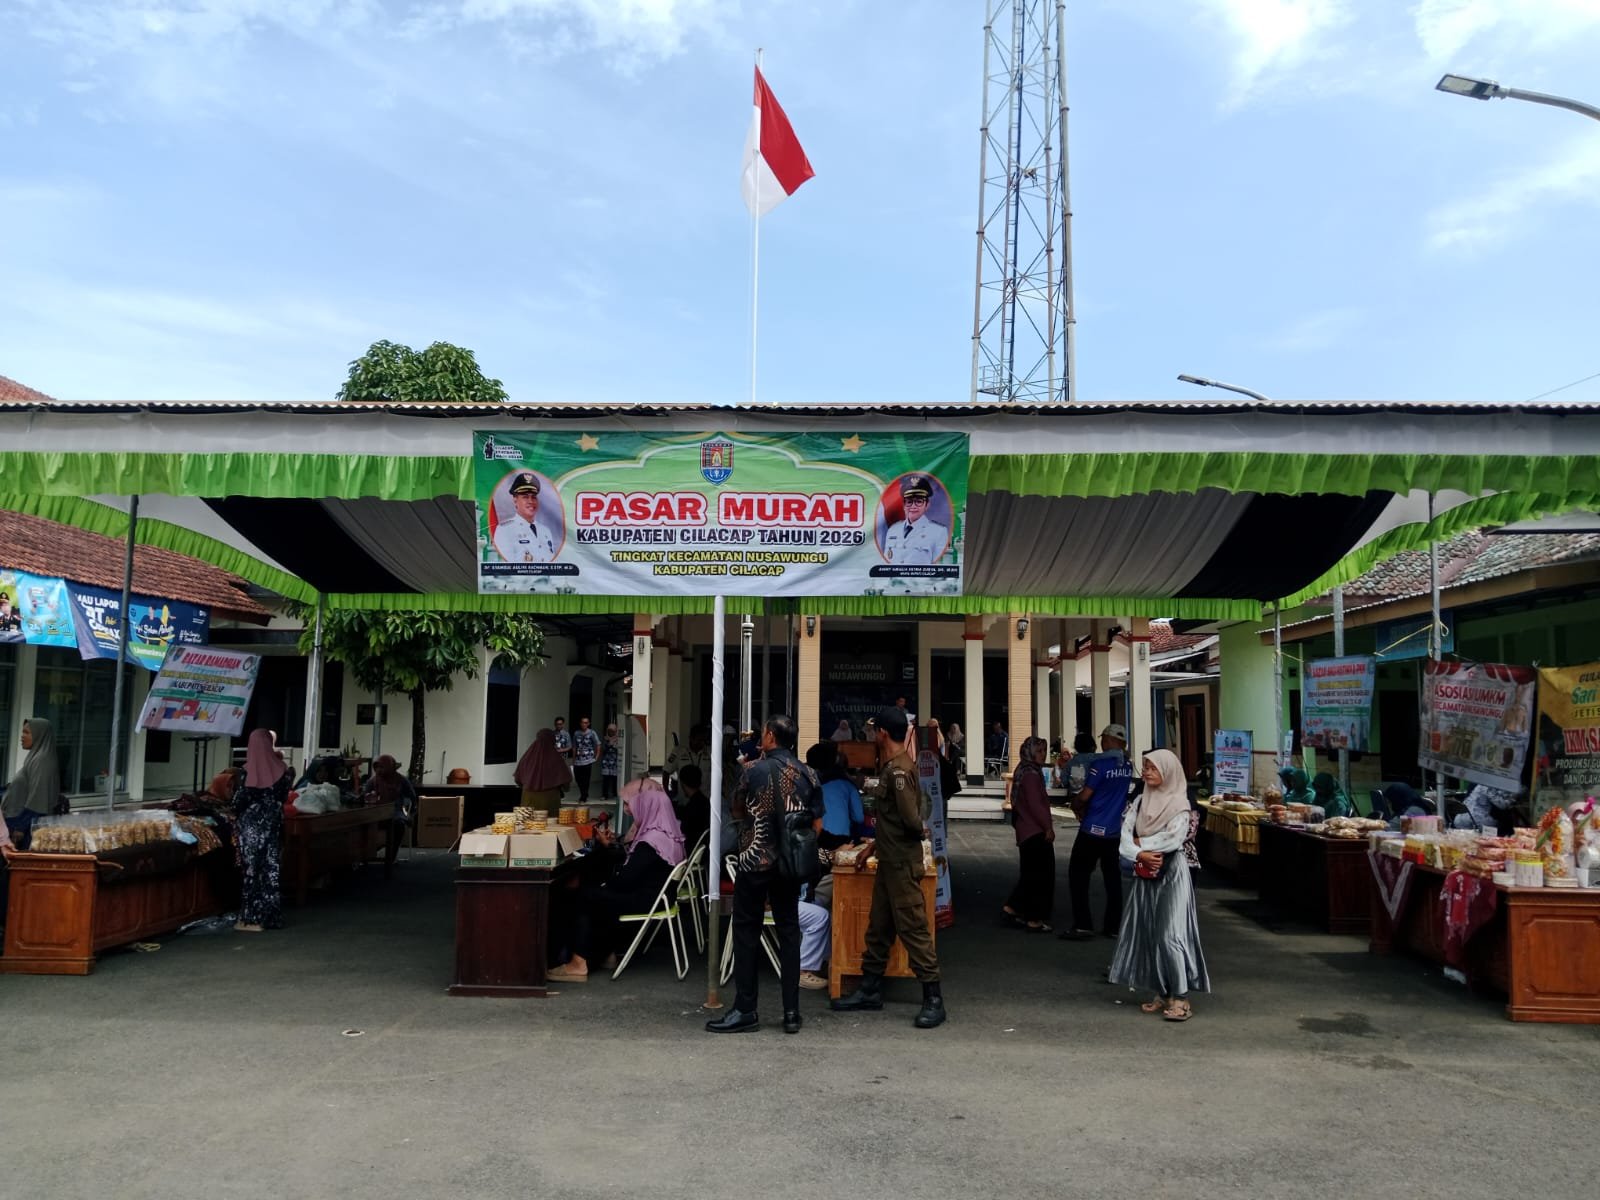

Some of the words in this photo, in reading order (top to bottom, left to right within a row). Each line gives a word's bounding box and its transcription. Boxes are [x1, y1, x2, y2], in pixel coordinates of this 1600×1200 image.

[579, 495, 704, 523] PASAR
[721, 495, 861, 524] MURAH
[577, 529, 676, 544] KABUPATEN
[680, 529, 754, 544] CILACAP
[758, 530, 816, 545] TAHUN
[820, 530, 865, 545] 2026
[610, 551, 665, 562] TINGKAT
[667, 551, 742, 562] KECAMATAN
[745, 552, 828, 563] NUSAWUNGU
[653, 564, 727, 576] KABUPATEN
[730, 565, 785, 576] CILACAP
[95, 597, 119, 609] LAPOR
[833, 663, 882, 671] KECAMATAN
[829, 672, 886, 681] NUSAWUNGU
[1571, 686, 1597, 704] Sari
[1564, 729, 1589, 754] IKM
[1590, 727, 1600, 753] S
[1555, 758, 1591, 769] PRODUKSI
